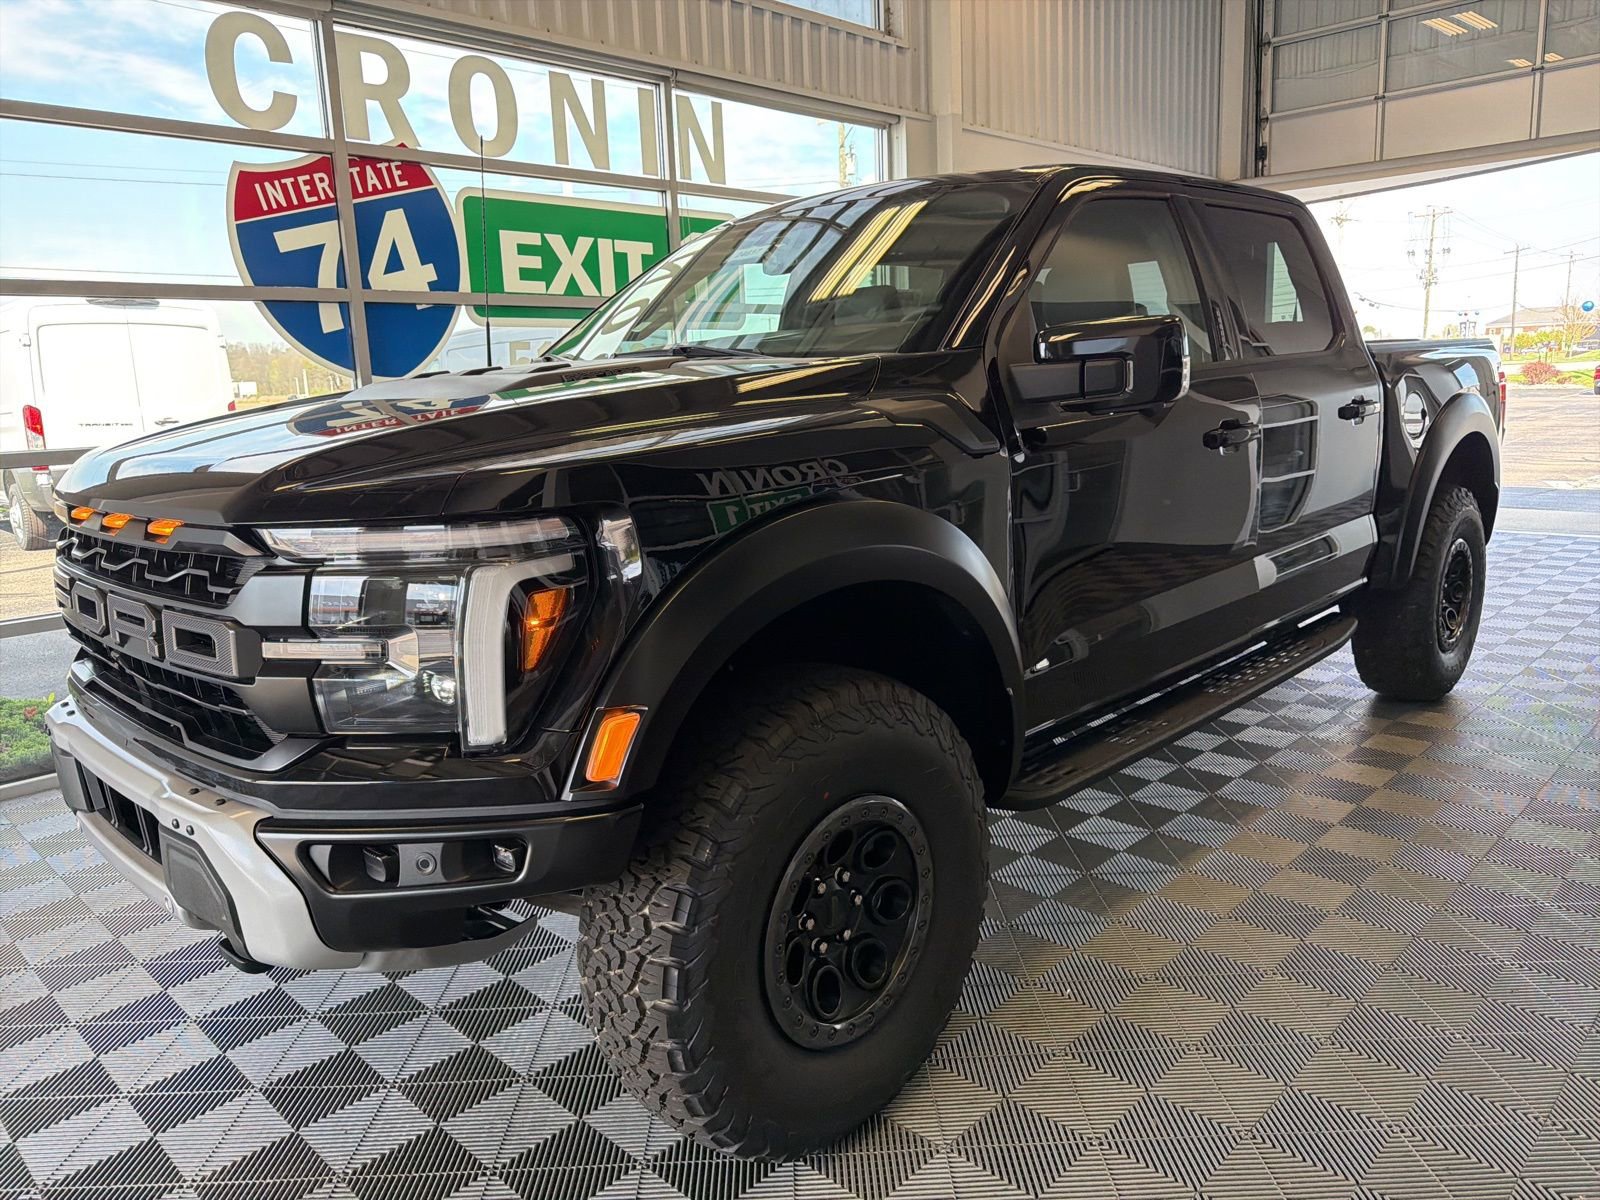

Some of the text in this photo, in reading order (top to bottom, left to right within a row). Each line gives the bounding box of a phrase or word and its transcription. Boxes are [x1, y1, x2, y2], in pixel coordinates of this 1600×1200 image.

[205, 11, 726, 185] CRONIN
[254, 161, 409, 212] INTERTATE
[273, 207, 438, 334] 74
[499, 229, 654, 298] EXIT
